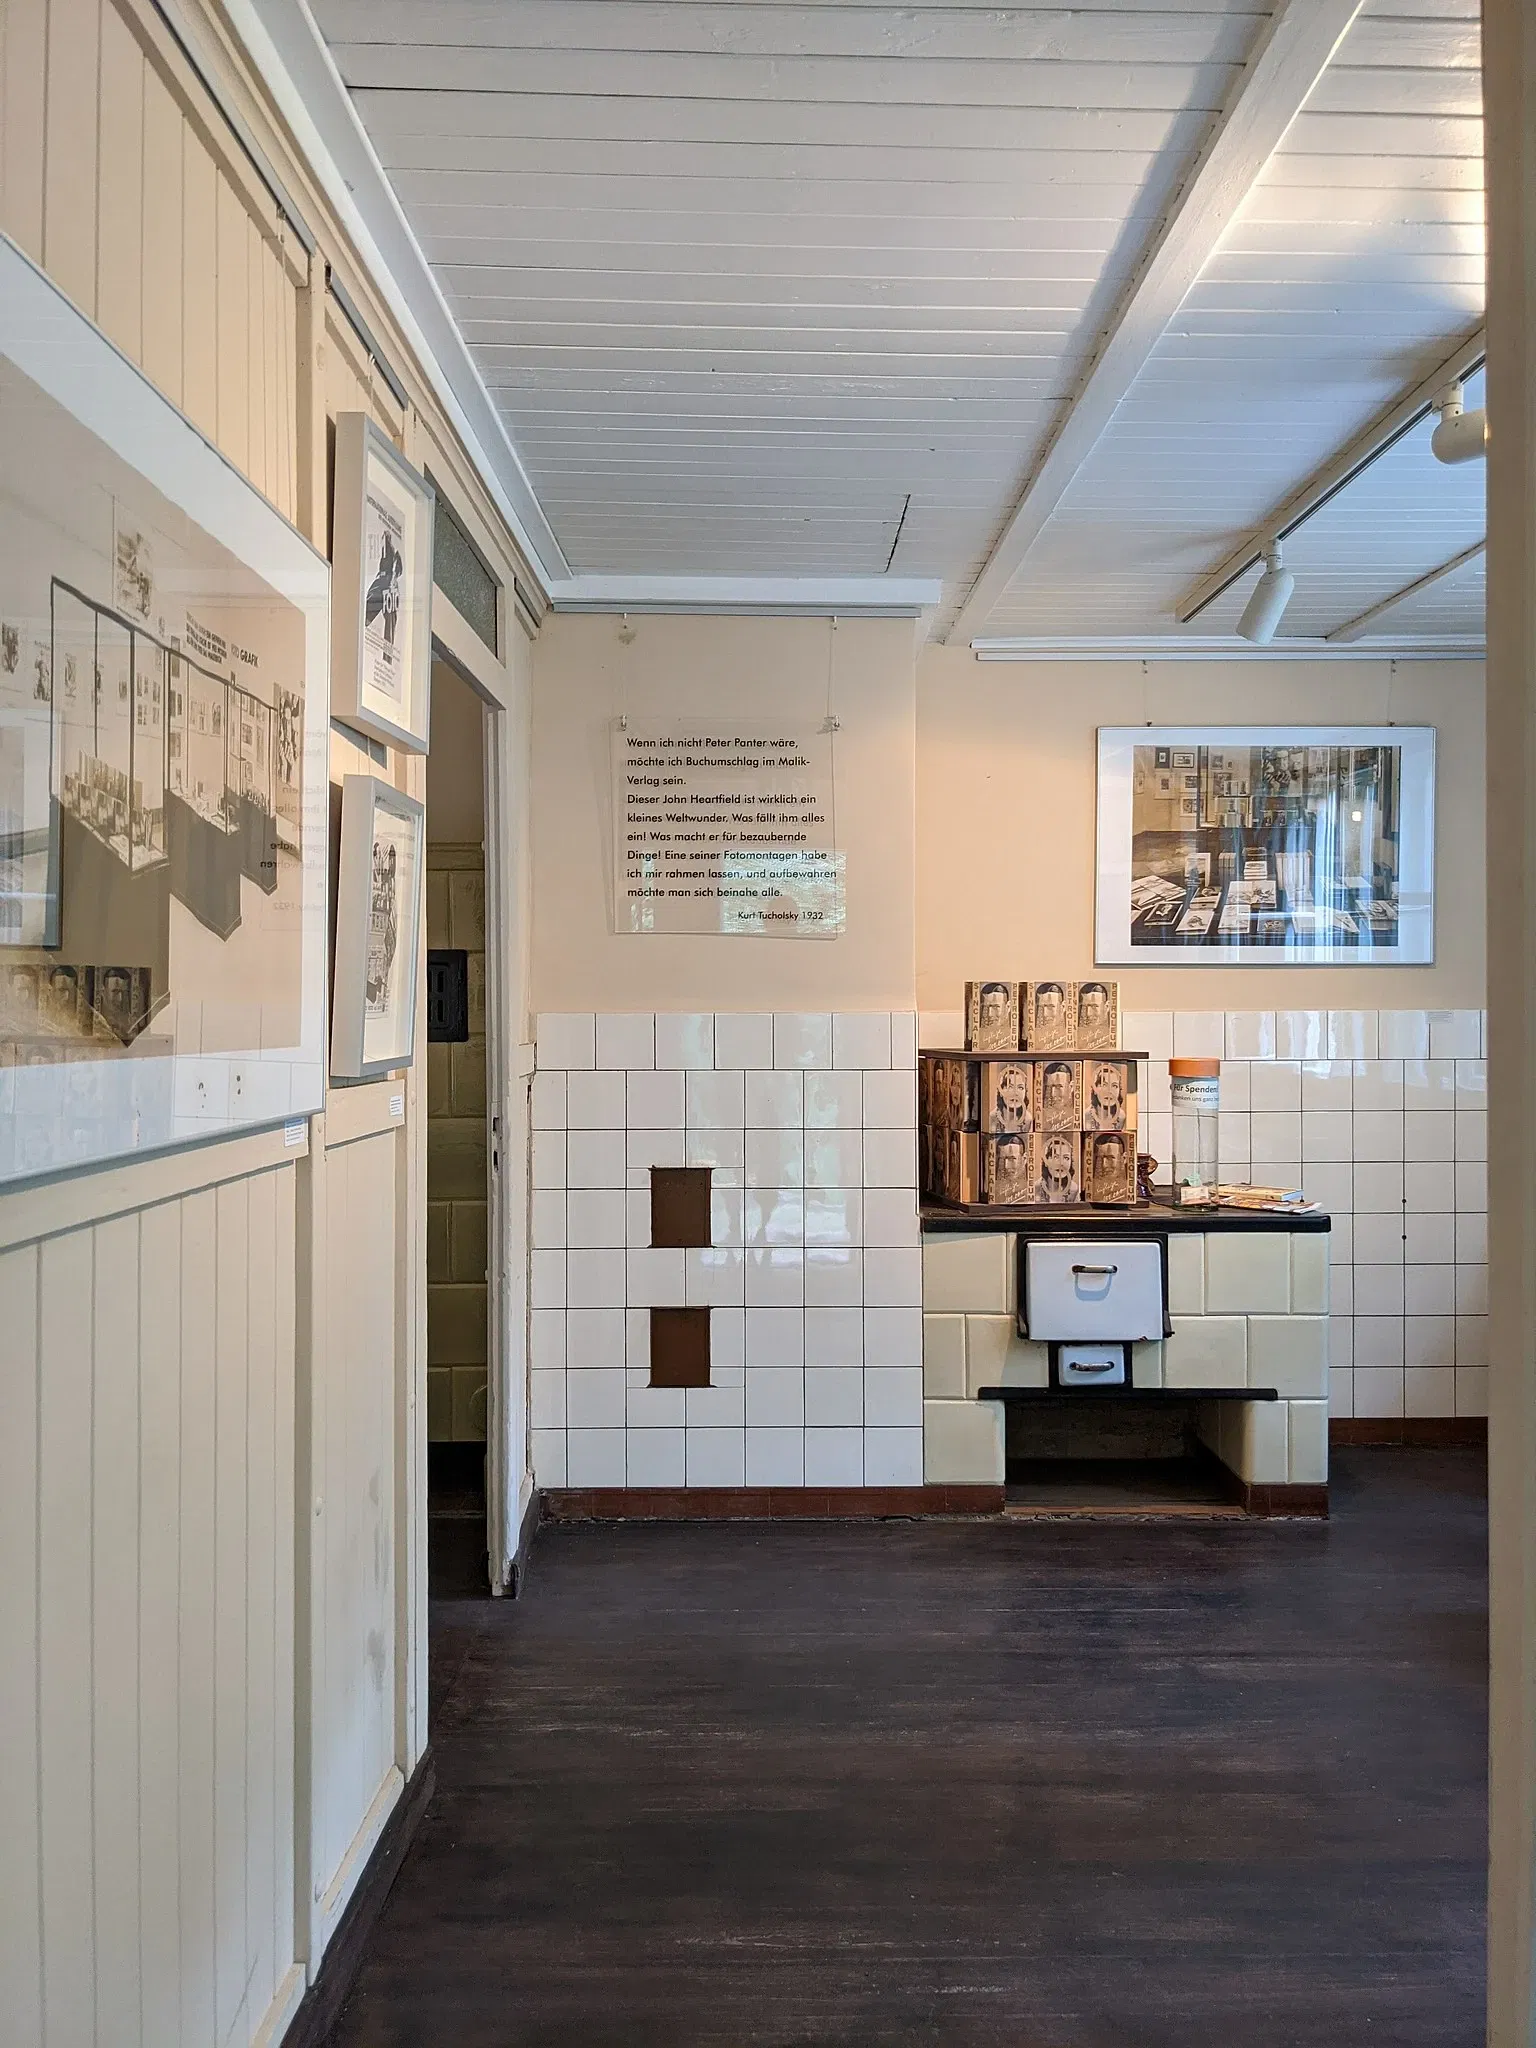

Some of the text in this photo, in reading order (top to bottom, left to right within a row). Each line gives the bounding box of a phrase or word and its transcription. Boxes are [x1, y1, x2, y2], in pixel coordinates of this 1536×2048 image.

[627, 738, 798, 748] Wenn ich nicht Peter Panter wäre,
[627, 757, 810, 768] möchte ich Buchumschlag im Malik-
[627, 775, 687, 787] Verlag sein.
[627, 794, 816, 803] Dieser John Heartfield ist wirklich ein
[627, 813, 825, 823] kleines Weltwunder. Was fällt ihm alles
[627, 832, 646, 841] ein!
[650, 832, 671, 841] Was
[674, 832, 705, 841] macht
[722, 831, 737, 841] für
[740, 832, 807, 841] bezaubernde
[627, 850, 827, 861] Dinge! Eine seiner Fotomontagen habe
[627, 869, 837, 879] ich mir rahmen lassen, und aufbewahren
[627, 887, 665, 896] möchte
[694, 887, 713, 896] sich
[717, 887, 758, 896] beinahe
[761, 887, 783, 896] alle.
[738, 911, 824, 920] Kurt Tucholsky 1932
[1010, 983, 1018, 1048] PETROLEUM
[1066, 983, 1074, 1048] PETROLEUM
[1110, 983, 1118, 1048] PETROLEUM
[1073, 1062, 1081, 1129] PETROLEUM
[1128, 1133, 1136, 1201] PETROLEUM
